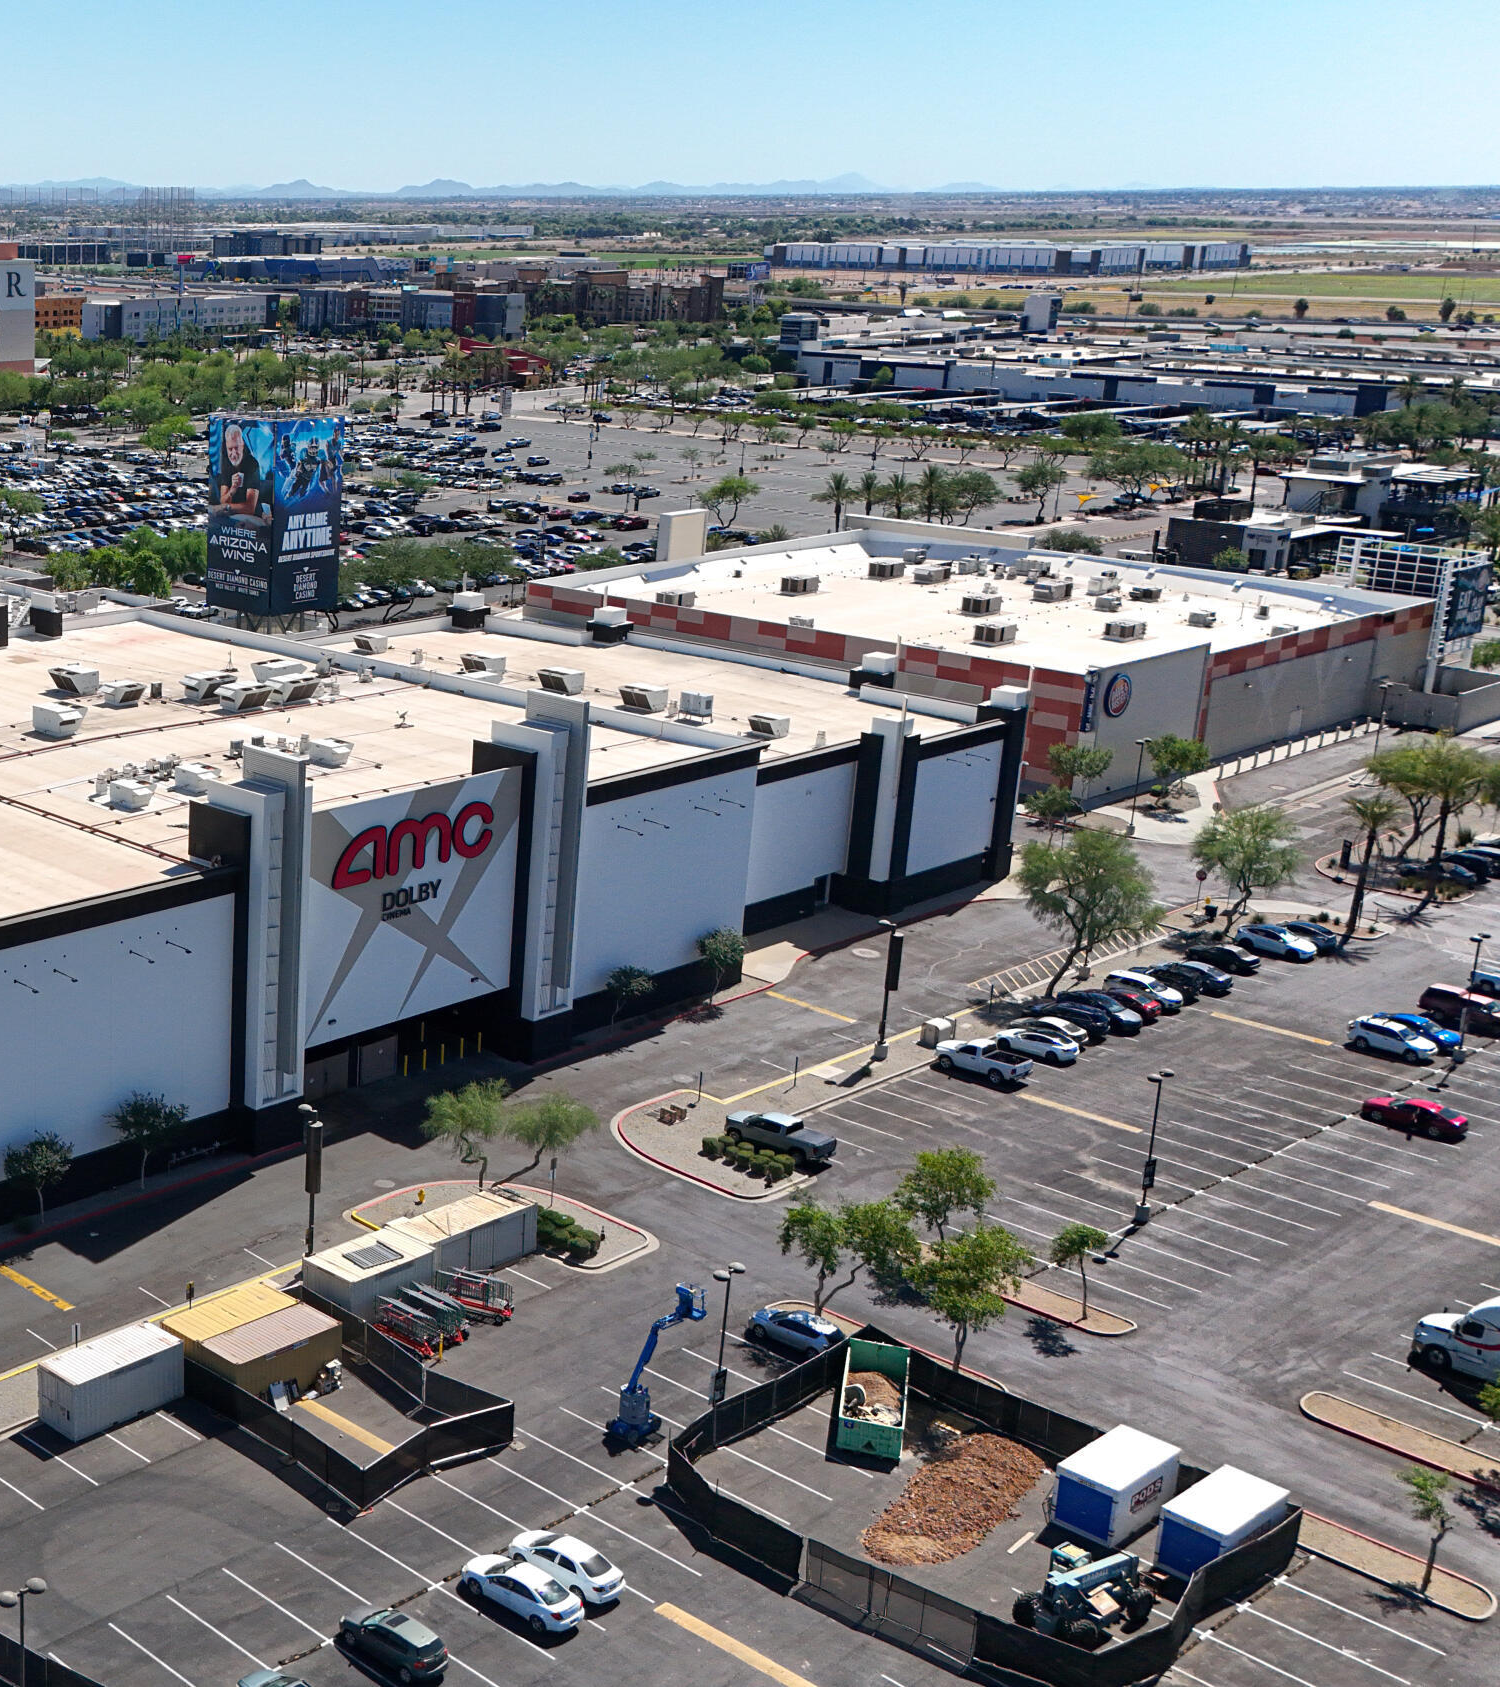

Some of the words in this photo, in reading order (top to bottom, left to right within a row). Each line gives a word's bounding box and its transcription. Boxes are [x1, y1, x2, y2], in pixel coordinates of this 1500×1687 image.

[6, 271, 27, 298] R
[287, 513, 305, 530] ANY
[305, 511, 329, 528] GAME
[221, 526, 257, 539] WHERE
[282, 526, 333, 551] ANYTIME
[209, 534, 268, 554] ARIZONA
[221, 547, 255, 563] WINS
[207, 570, 226, 581] DESERT
[226, 573, 249, 586] DIAMOND
[249, 577, 268, 590] CASINO
[293, 581, 318, 592] DIAMOND
[295, 573, 316, 584] DESERT
[295, 589, 315, 600] CASINO
[381, 878, 442, 912] DOLBY
[381, 907, 412, 921] CINEMA
[1131, 1478, 1163, 1507] PODS
